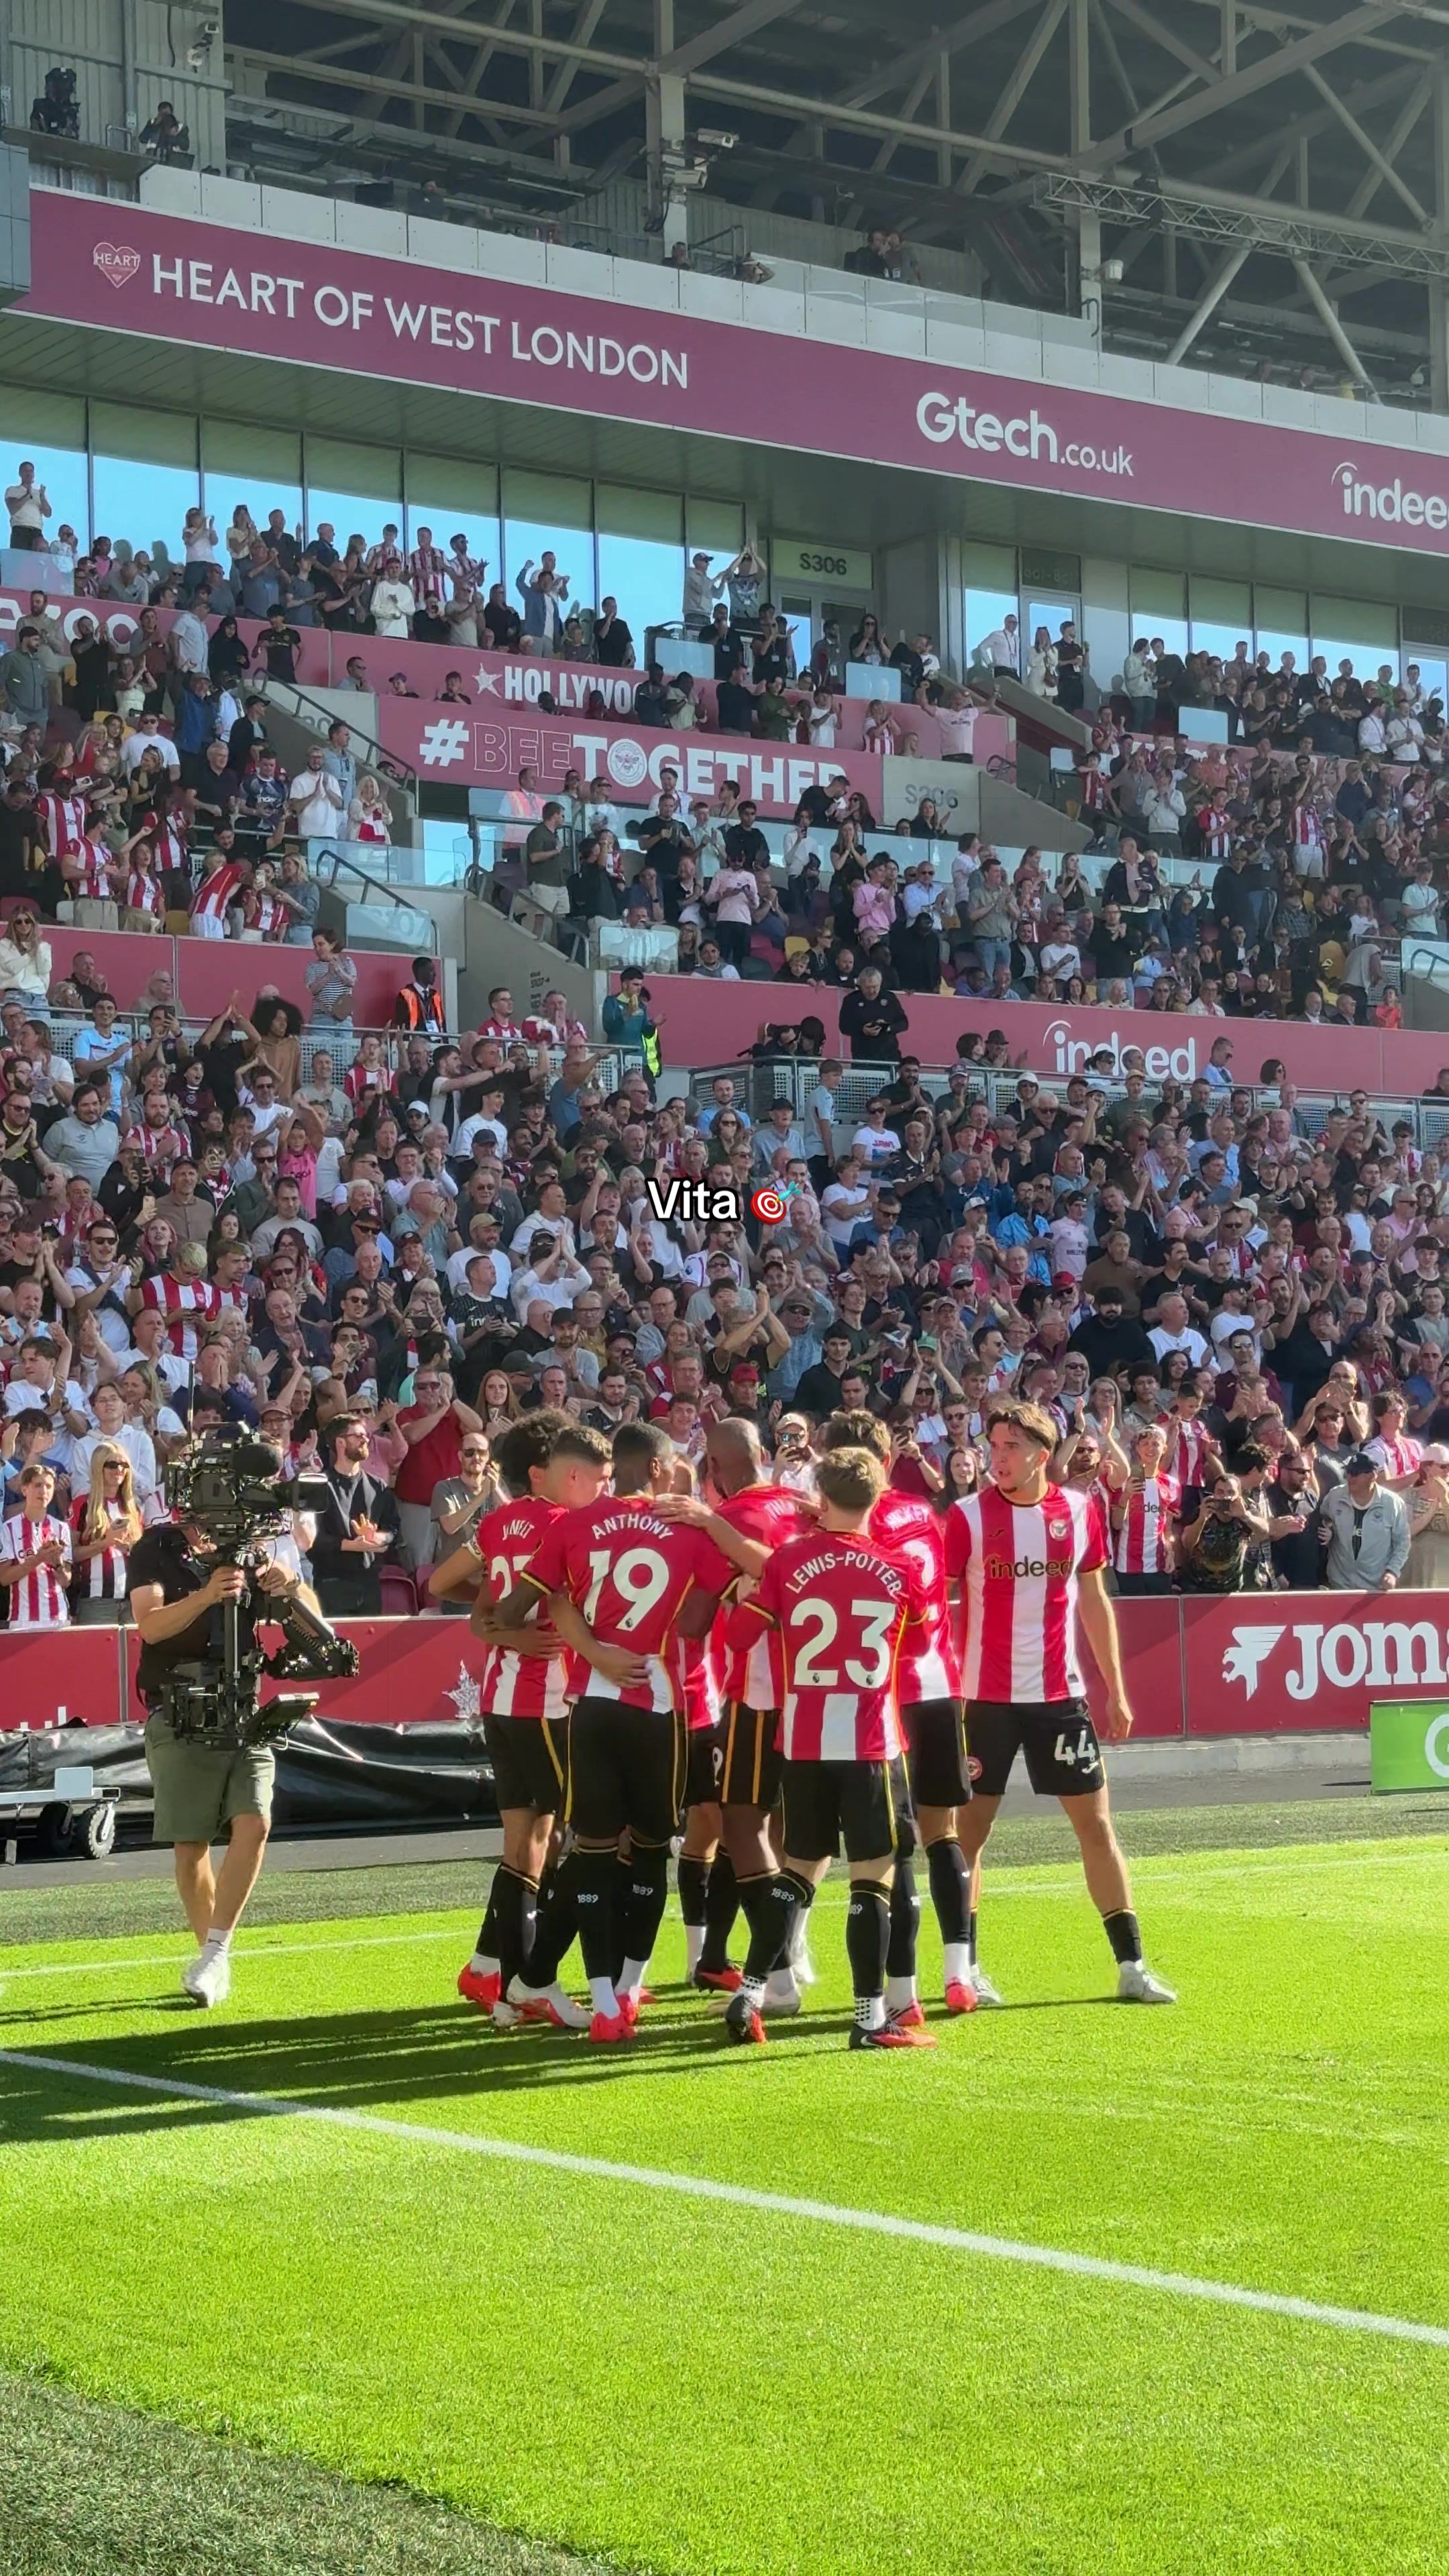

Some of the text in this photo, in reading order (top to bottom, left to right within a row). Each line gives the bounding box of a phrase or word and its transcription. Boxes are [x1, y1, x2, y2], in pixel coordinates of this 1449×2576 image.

[95, 252, 140, 267] HEART
[152, 254, 688, 389] HEART OF WEST LONDON
[916, 392, 1134, 476] Gtech.co.uk
[1342, 472, 1449, 530] indee
[800, 552, 847, 576] S306
[504, 665, 643, 714] HOLLYWO
[592, 1513, 674, 1540] ANTHONY
[584, 1548, 669, 1631] 19
[785, 1551, 904, 1597] LEWIS-POTTER
[790, 1598, 897, 1688] 23
[1285, 1621, 1449, 1700] Jom
[1055, 1730, 1095, 1765] 44
[578, 1894, 598, 1903] 1889
